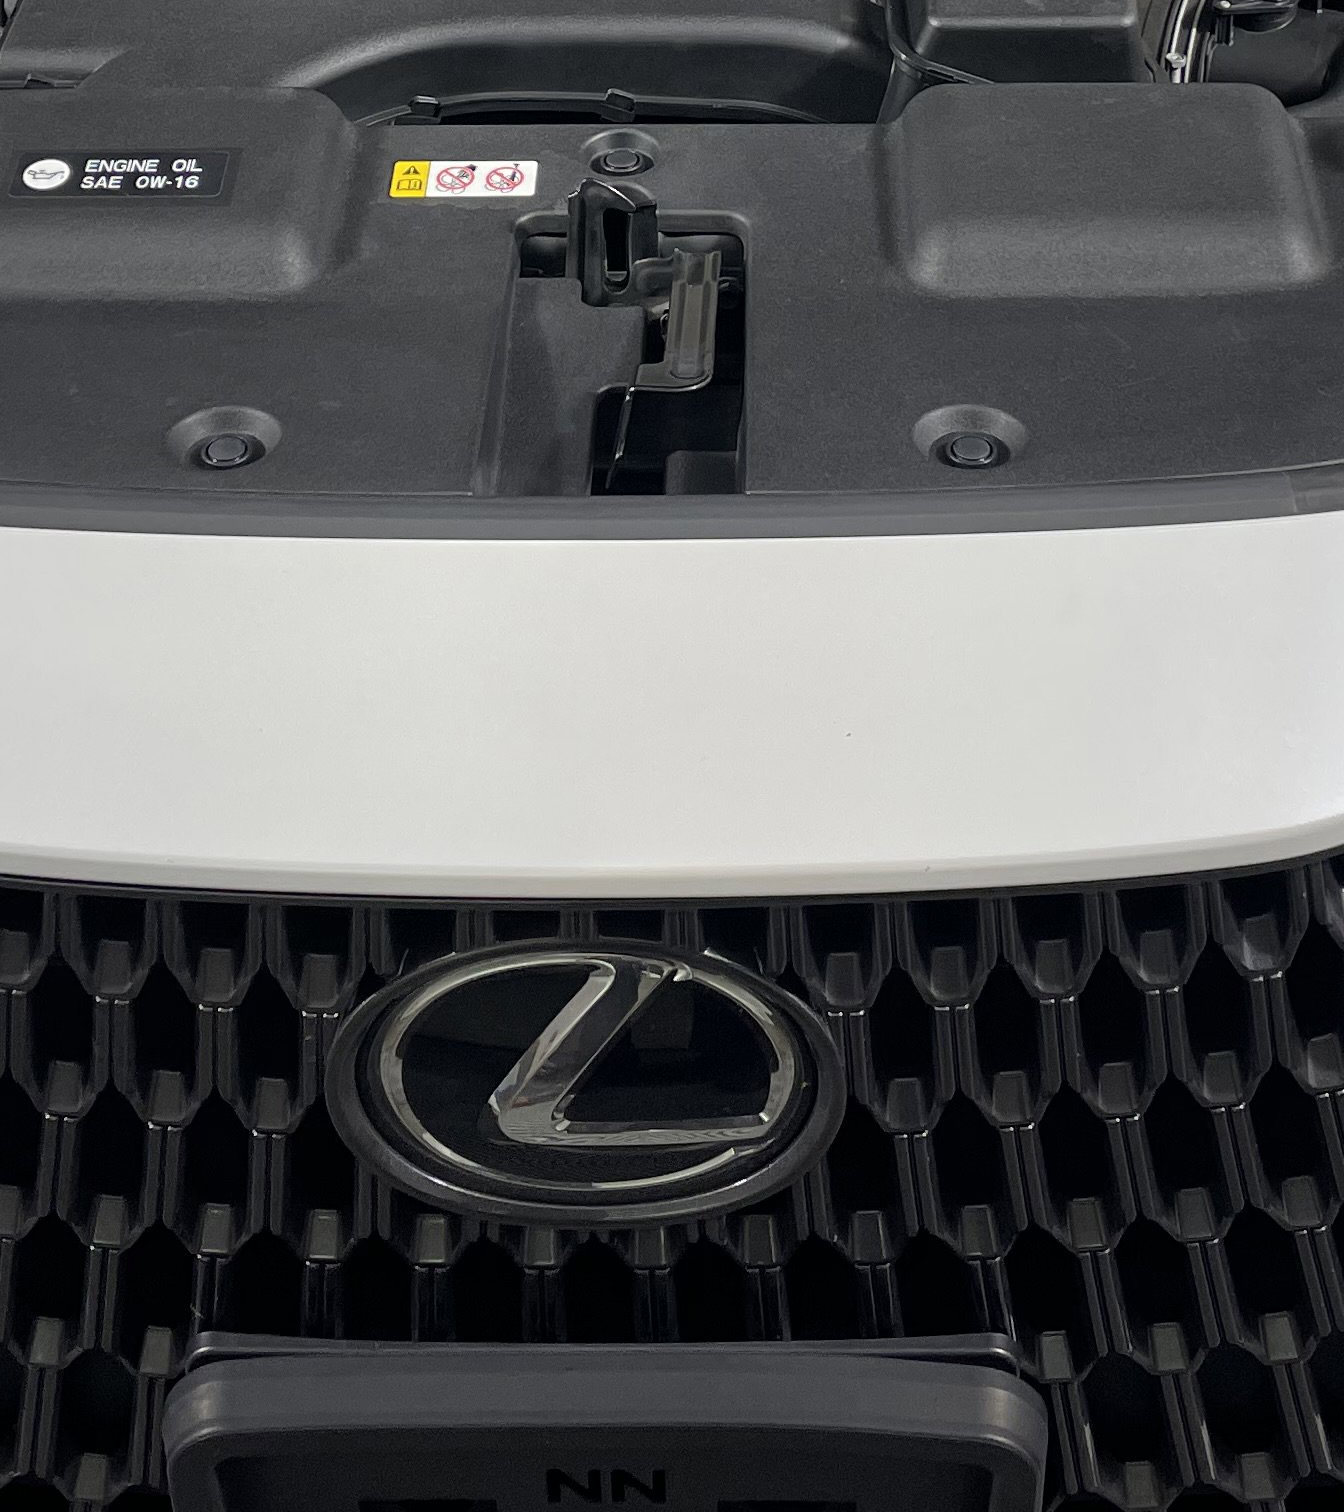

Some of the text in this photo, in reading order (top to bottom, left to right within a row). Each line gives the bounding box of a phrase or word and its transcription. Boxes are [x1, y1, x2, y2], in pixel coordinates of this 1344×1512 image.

[84, 158, 203, 173] ENGINE OIL
[80, 175, 200, 189] SAE 0W-16
[546, 1468, 667, 1503] NN
